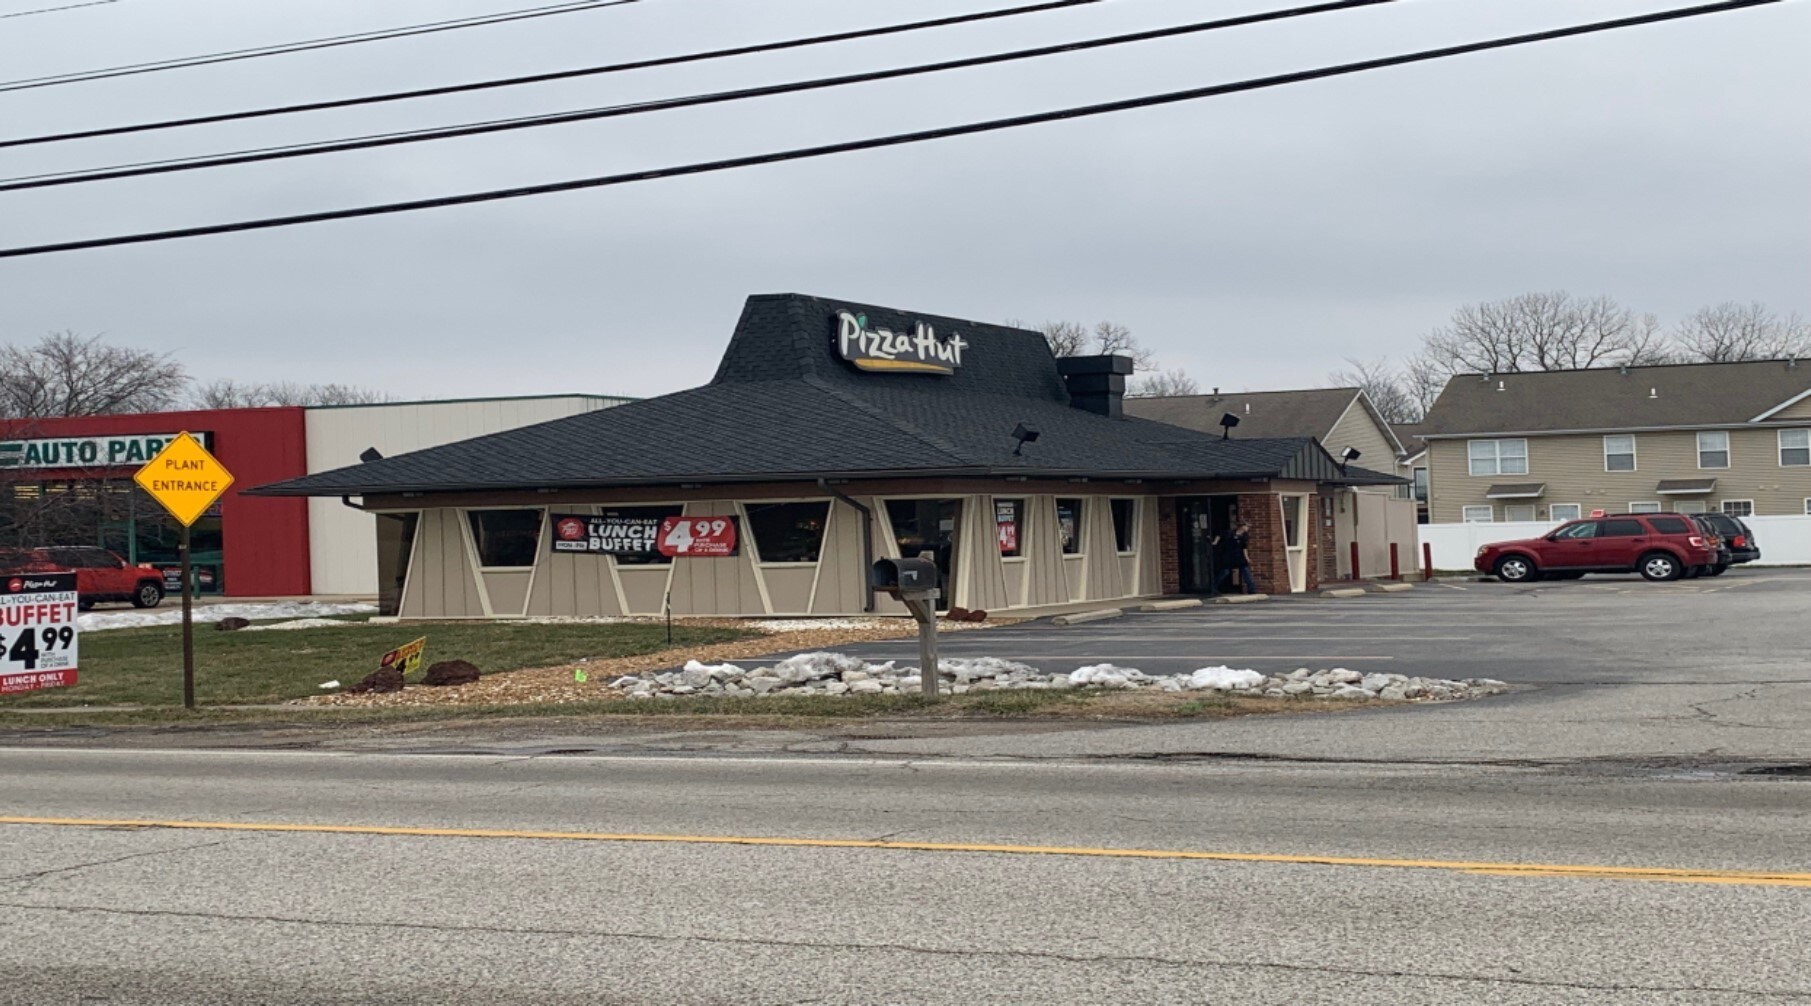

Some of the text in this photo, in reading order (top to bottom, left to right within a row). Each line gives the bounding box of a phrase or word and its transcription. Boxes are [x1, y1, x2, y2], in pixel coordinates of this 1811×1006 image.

[840, 312, 969, 365] Pizza Hut
[24, 436, 201, 466] AUTO PAR
[165, 459, 206, 471] PLANT
[152, 480, 218, 492] ENTRANCE
[588, 524, 658, 539] LUNCH
[589, 537, 656, 552] BUFFET
[0, 592, 75, 605] L-YOU-CAN-EAT
[2, 672, 65, 686] LUNCH ONLY
